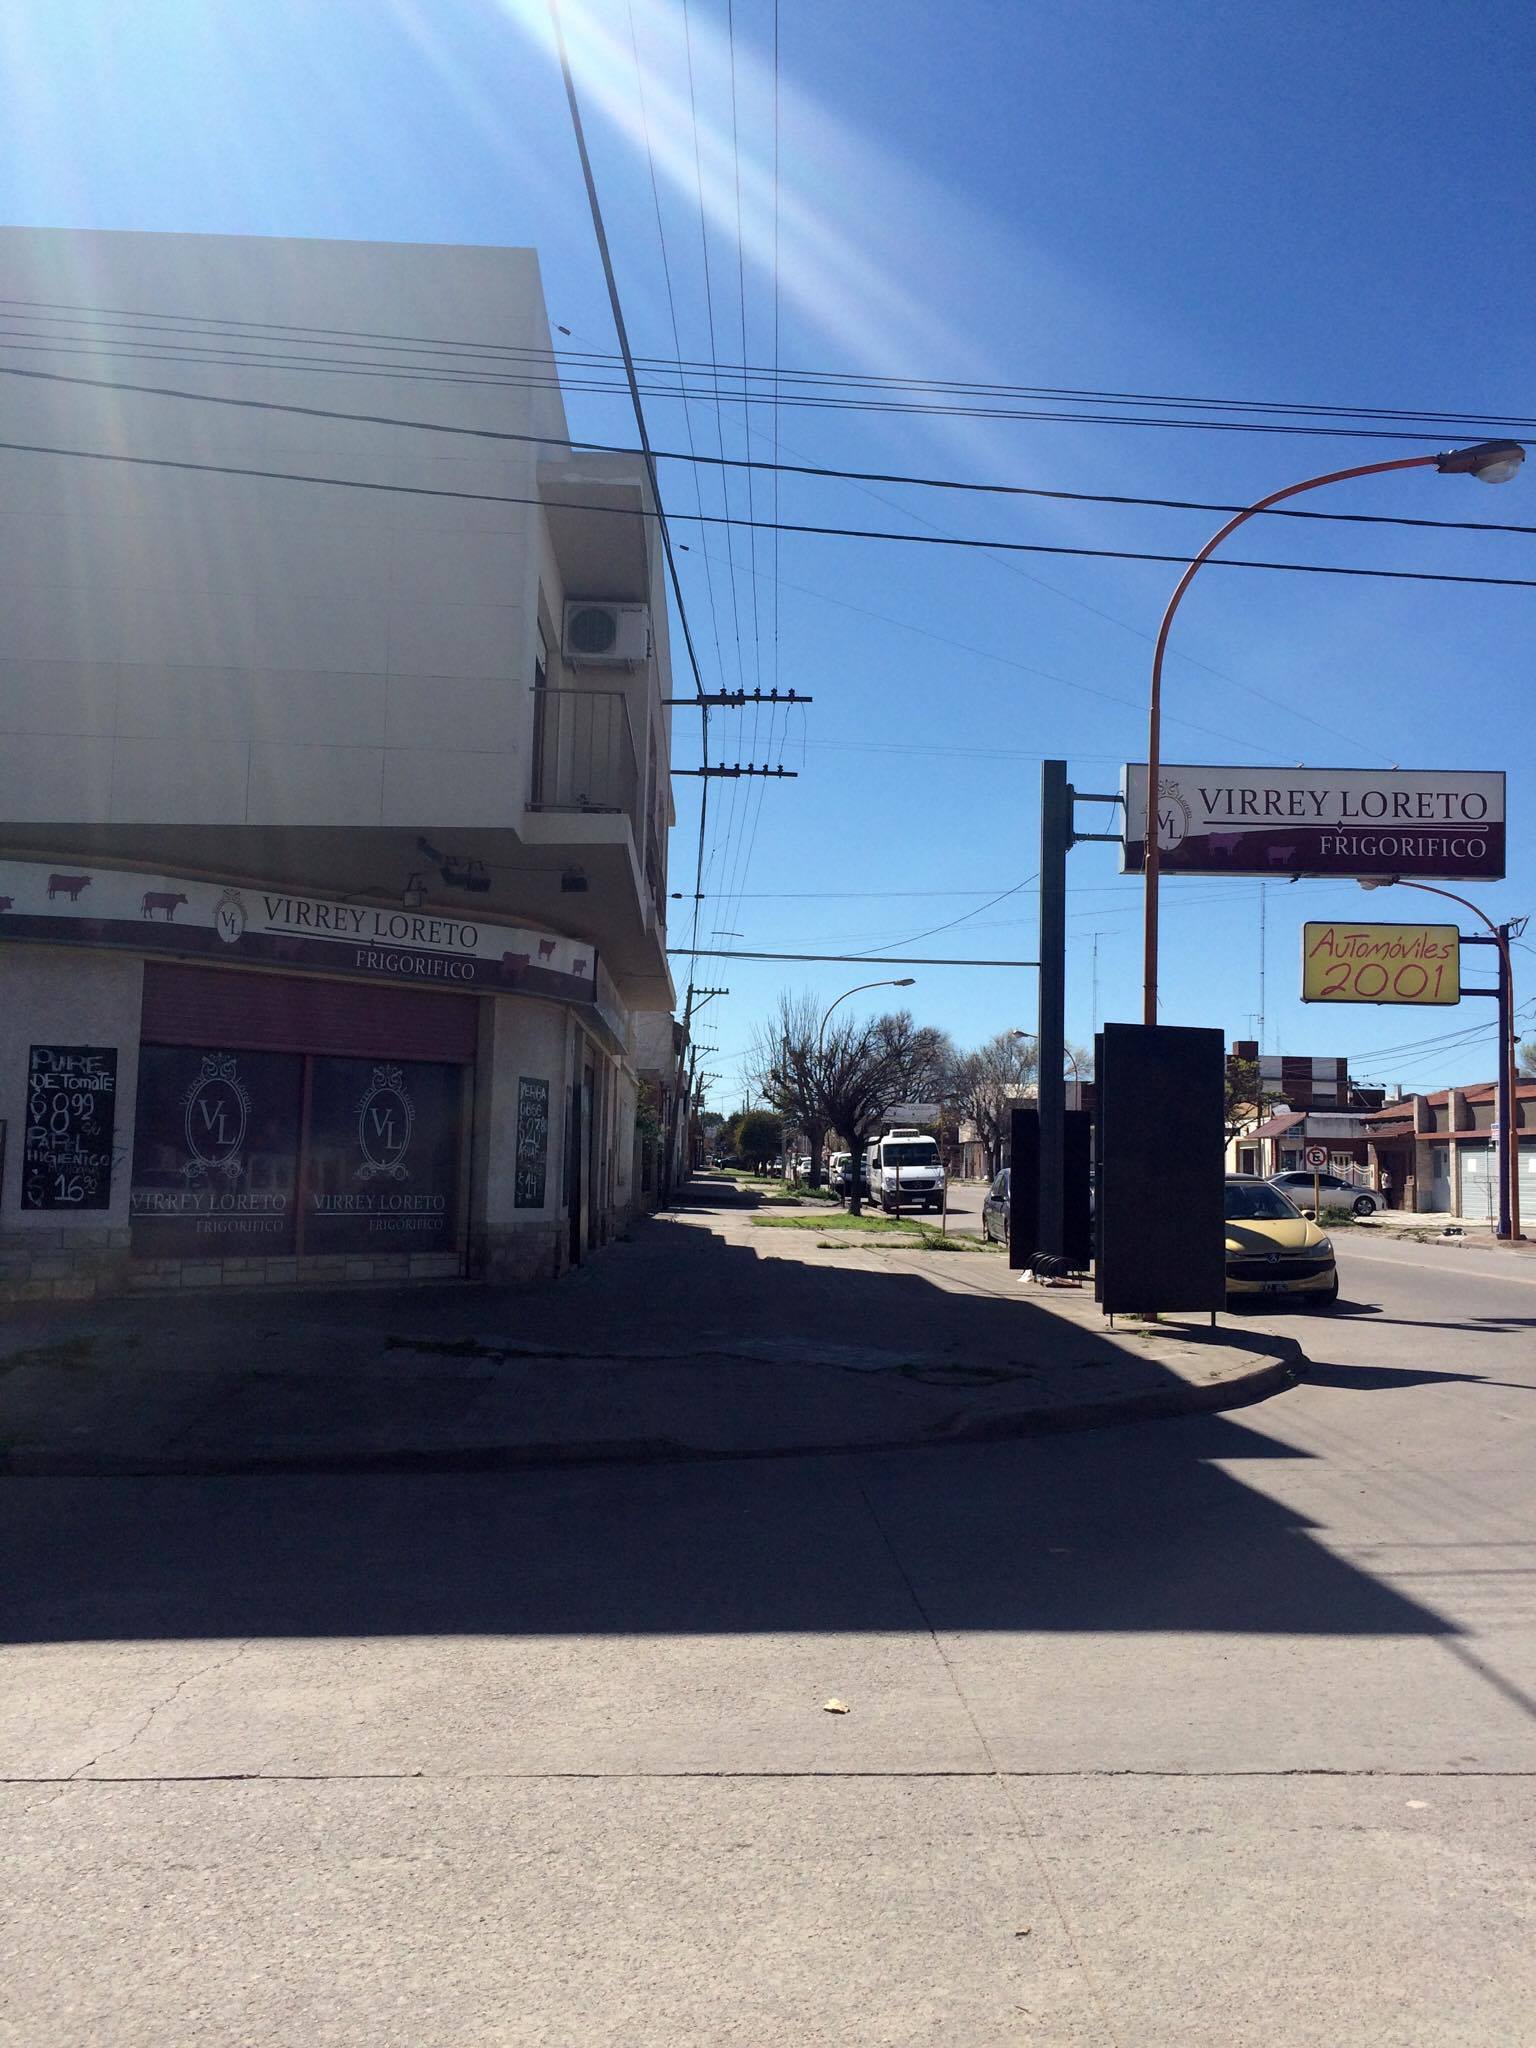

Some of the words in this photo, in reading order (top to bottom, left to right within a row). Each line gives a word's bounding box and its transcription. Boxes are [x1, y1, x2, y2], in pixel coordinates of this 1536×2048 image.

[1198, 788, 1331, 817] VIRREY
[1341, 791, 1489, 820] LORETO
[1319, 834, 1488, 859] FRIGORIFICO
[263, 896, 369, 933] VIRREY
[374, 912, 479, 949] LORETO
[355, 950, 476, 981] FRIGORIFICO
[1319, 962, 1445, 999] 2001
[198, 1099, 237, 1145] VL
[368, 1108, 402, 1150] VL
[131, 1193, 205, 1210] VIRREY
[210, 1194, 287, 1210] LORETO
[313, 1194, 376, 1210] VIRREY
[379, 1195, 446, 1211] LORETO
[196, 1220, 284, 1233] FRIGORIFICO
[368, 1219, 444, 1232] FRIGORIFICO
